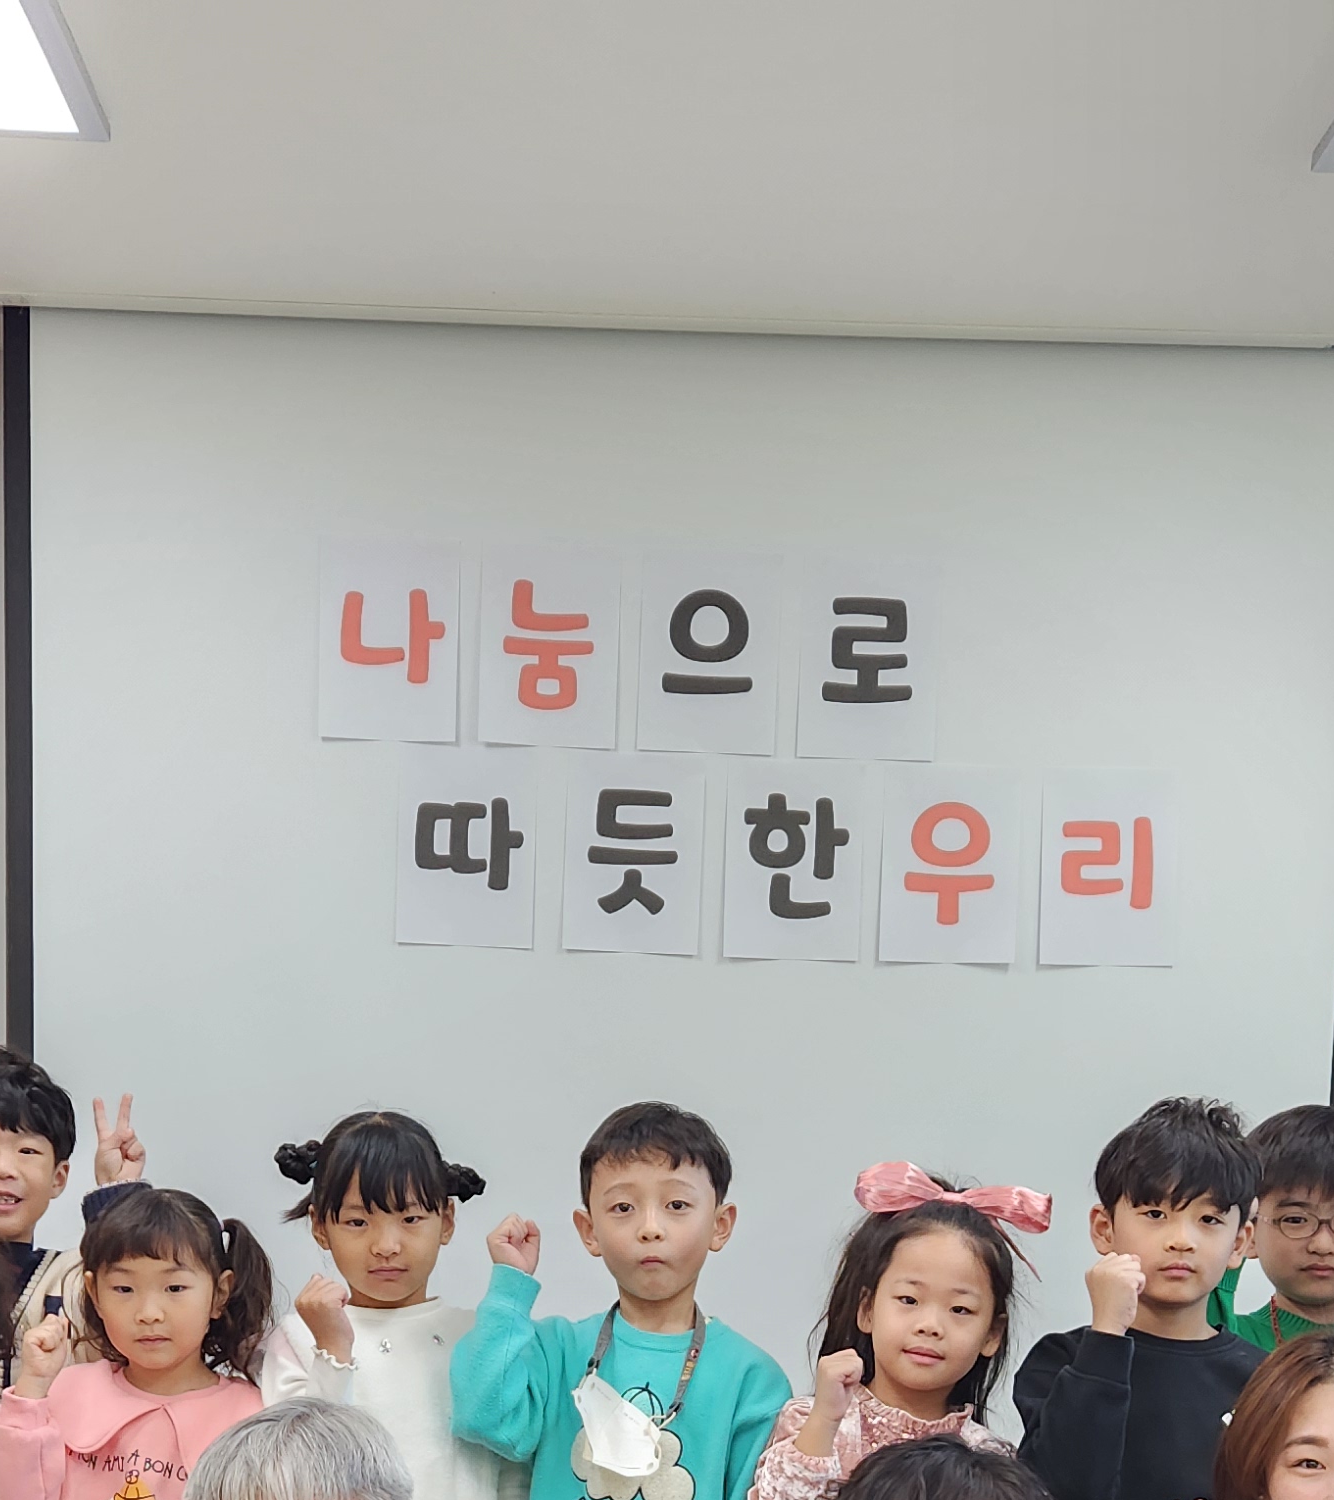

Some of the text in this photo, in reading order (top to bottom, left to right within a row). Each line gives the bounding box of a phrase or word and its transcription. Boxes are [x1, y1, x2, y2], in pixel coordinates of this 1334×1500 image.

[339, 578, 913, 710] 나눔으로
[904, 801, 1154, 926] 우리
[102, 1454, 124, 1472] AMI
[143, 1457, 174, 1479] BON
